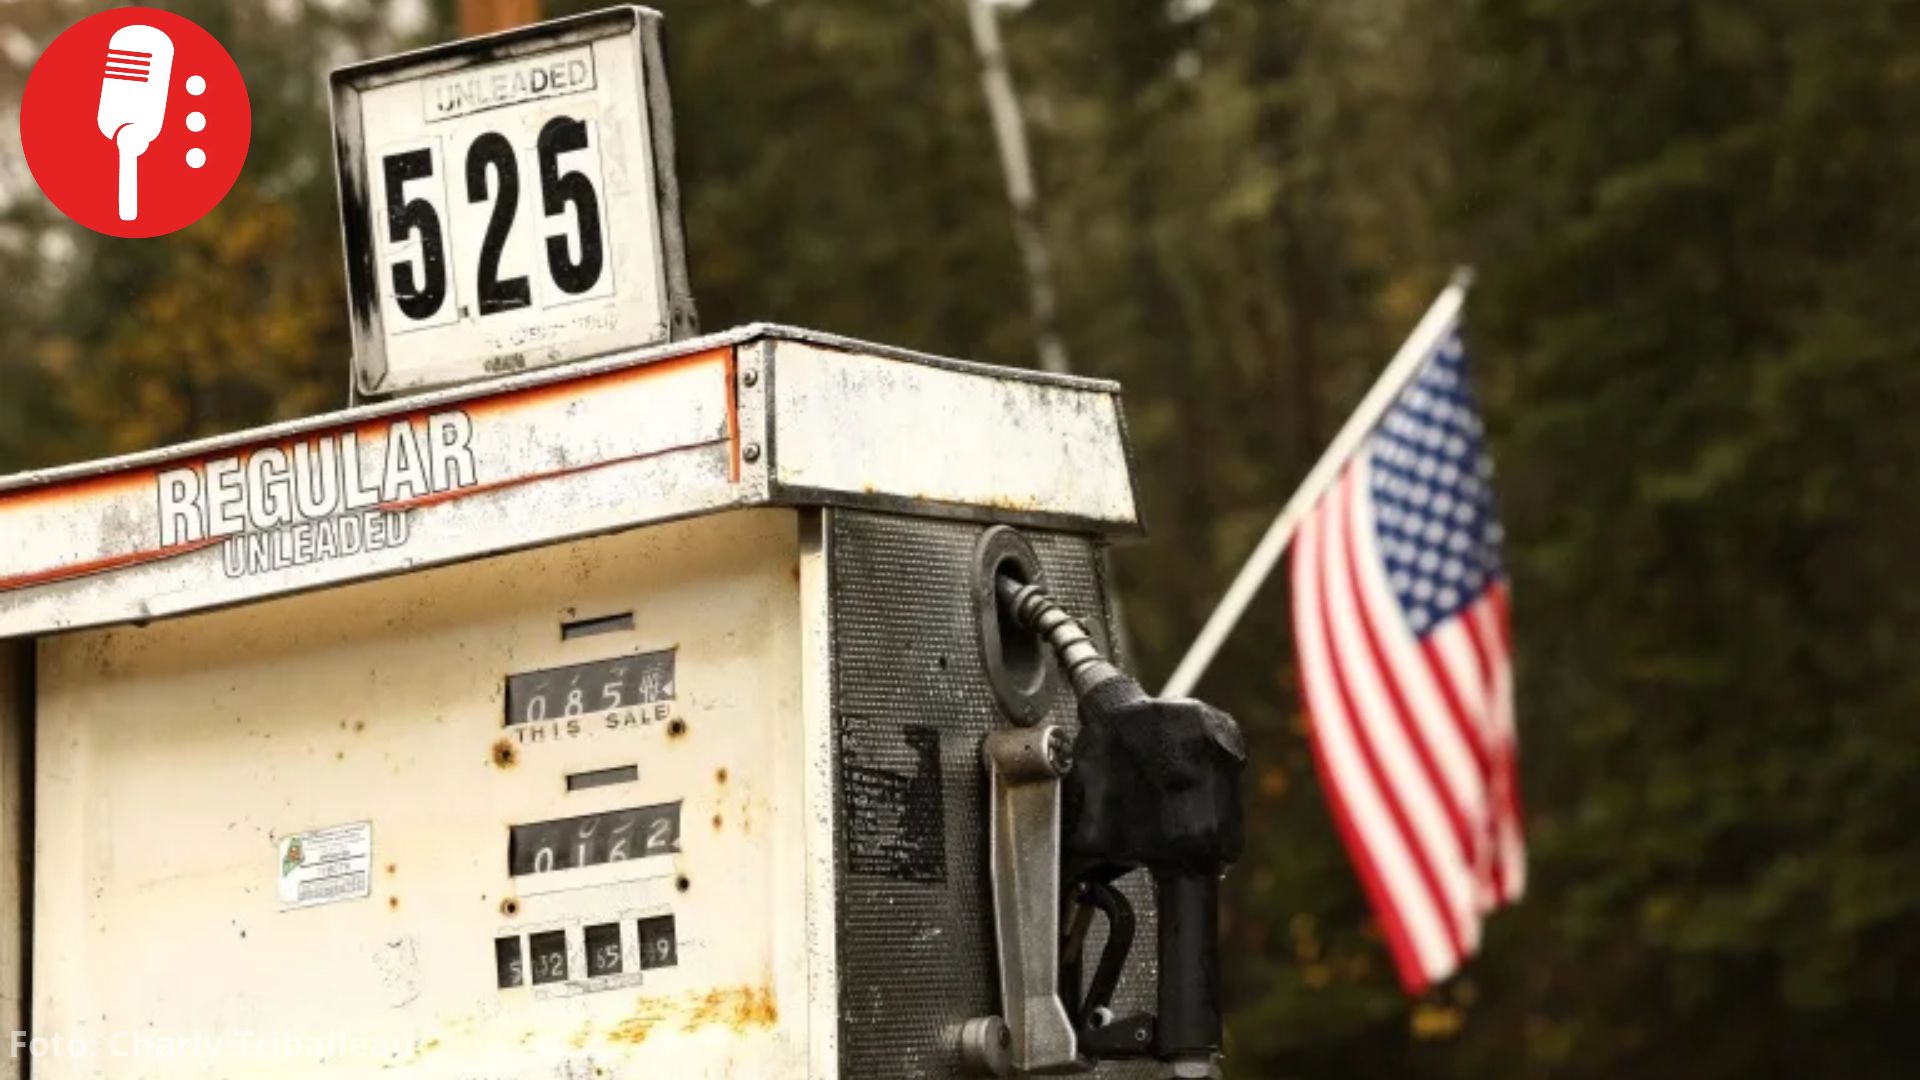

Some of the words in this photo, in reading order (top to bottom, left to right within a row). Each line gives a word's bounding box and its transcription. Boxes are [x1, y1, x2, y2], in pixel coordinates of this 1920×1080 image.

[436, 58, 588, 112] UNLEADED
[155, 408, 478, 548] REGULAR
[222, 506, 411, 578] UNLEADED
[515, 719, 581, 743] THIS
[605, 704, 668, 729] SALE
